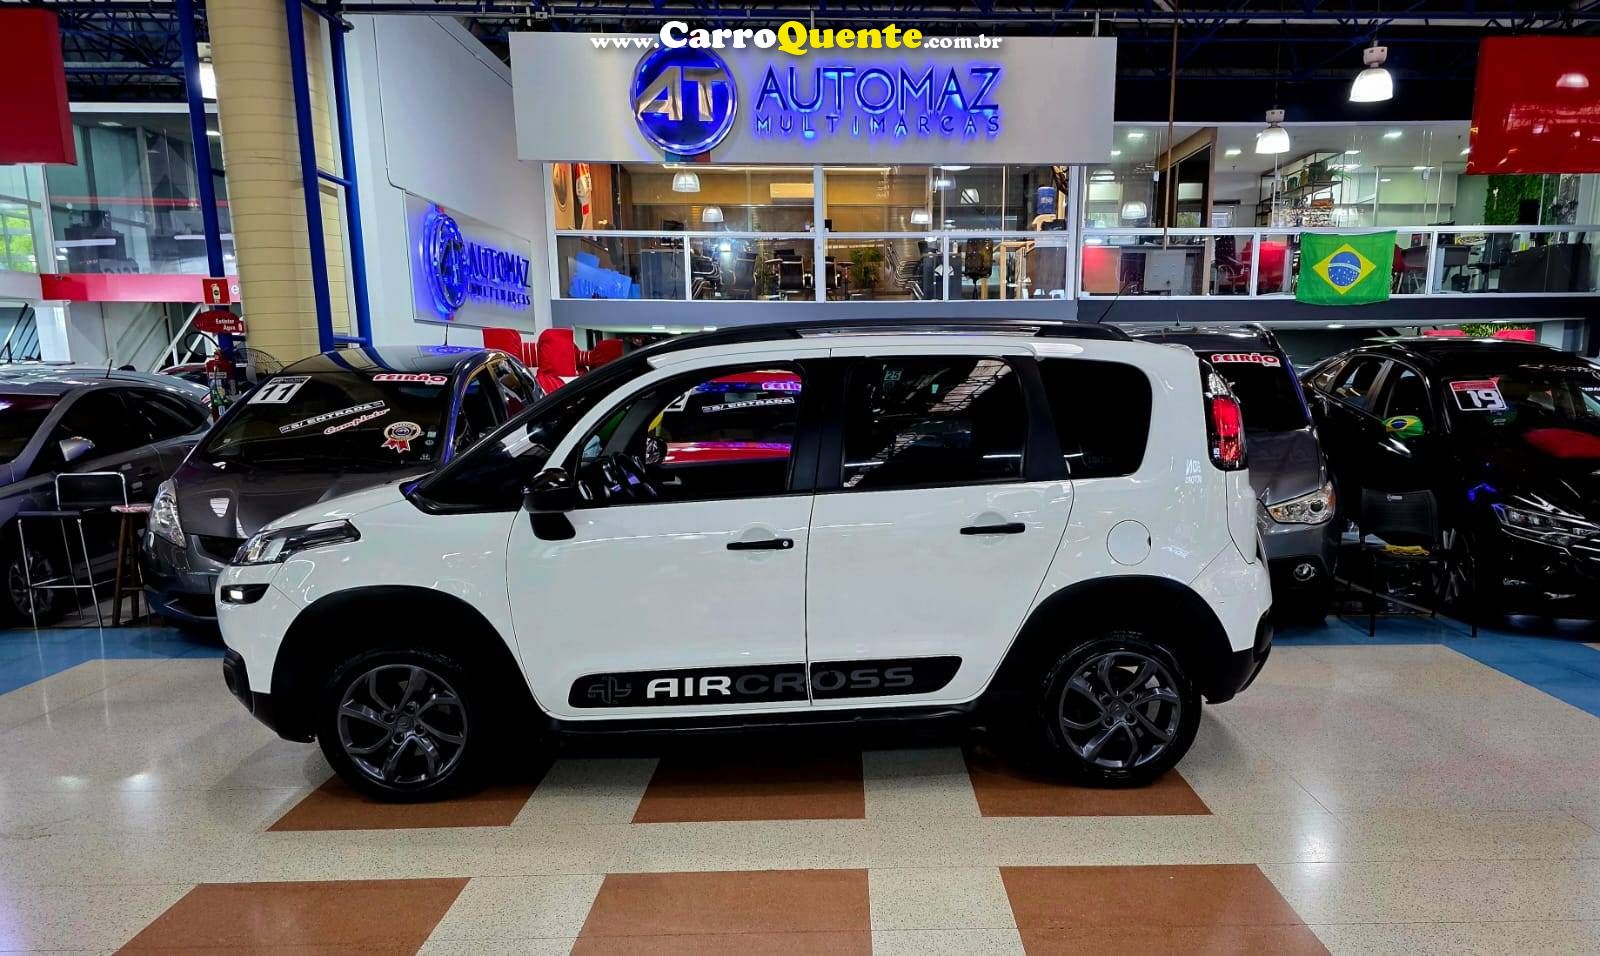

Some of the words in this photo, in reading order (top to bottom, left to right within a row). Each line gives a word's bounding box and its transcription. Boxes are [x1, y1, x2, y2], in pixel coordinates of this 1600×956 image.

[636, 65, 729, 122] AT
[755, 65, 1001, 114] AUTOMAZ
[756, 115, 1000, 135] MULTIMARCAS
[467, 242, 531, 288] AUTOMAZ
[259, 383, 297, 401] 11
[1466, 390, 1504, 410] 19
[307, 404, 374, 424] ENTRADA
[646, 666, 915, 699] AIRCROSS
